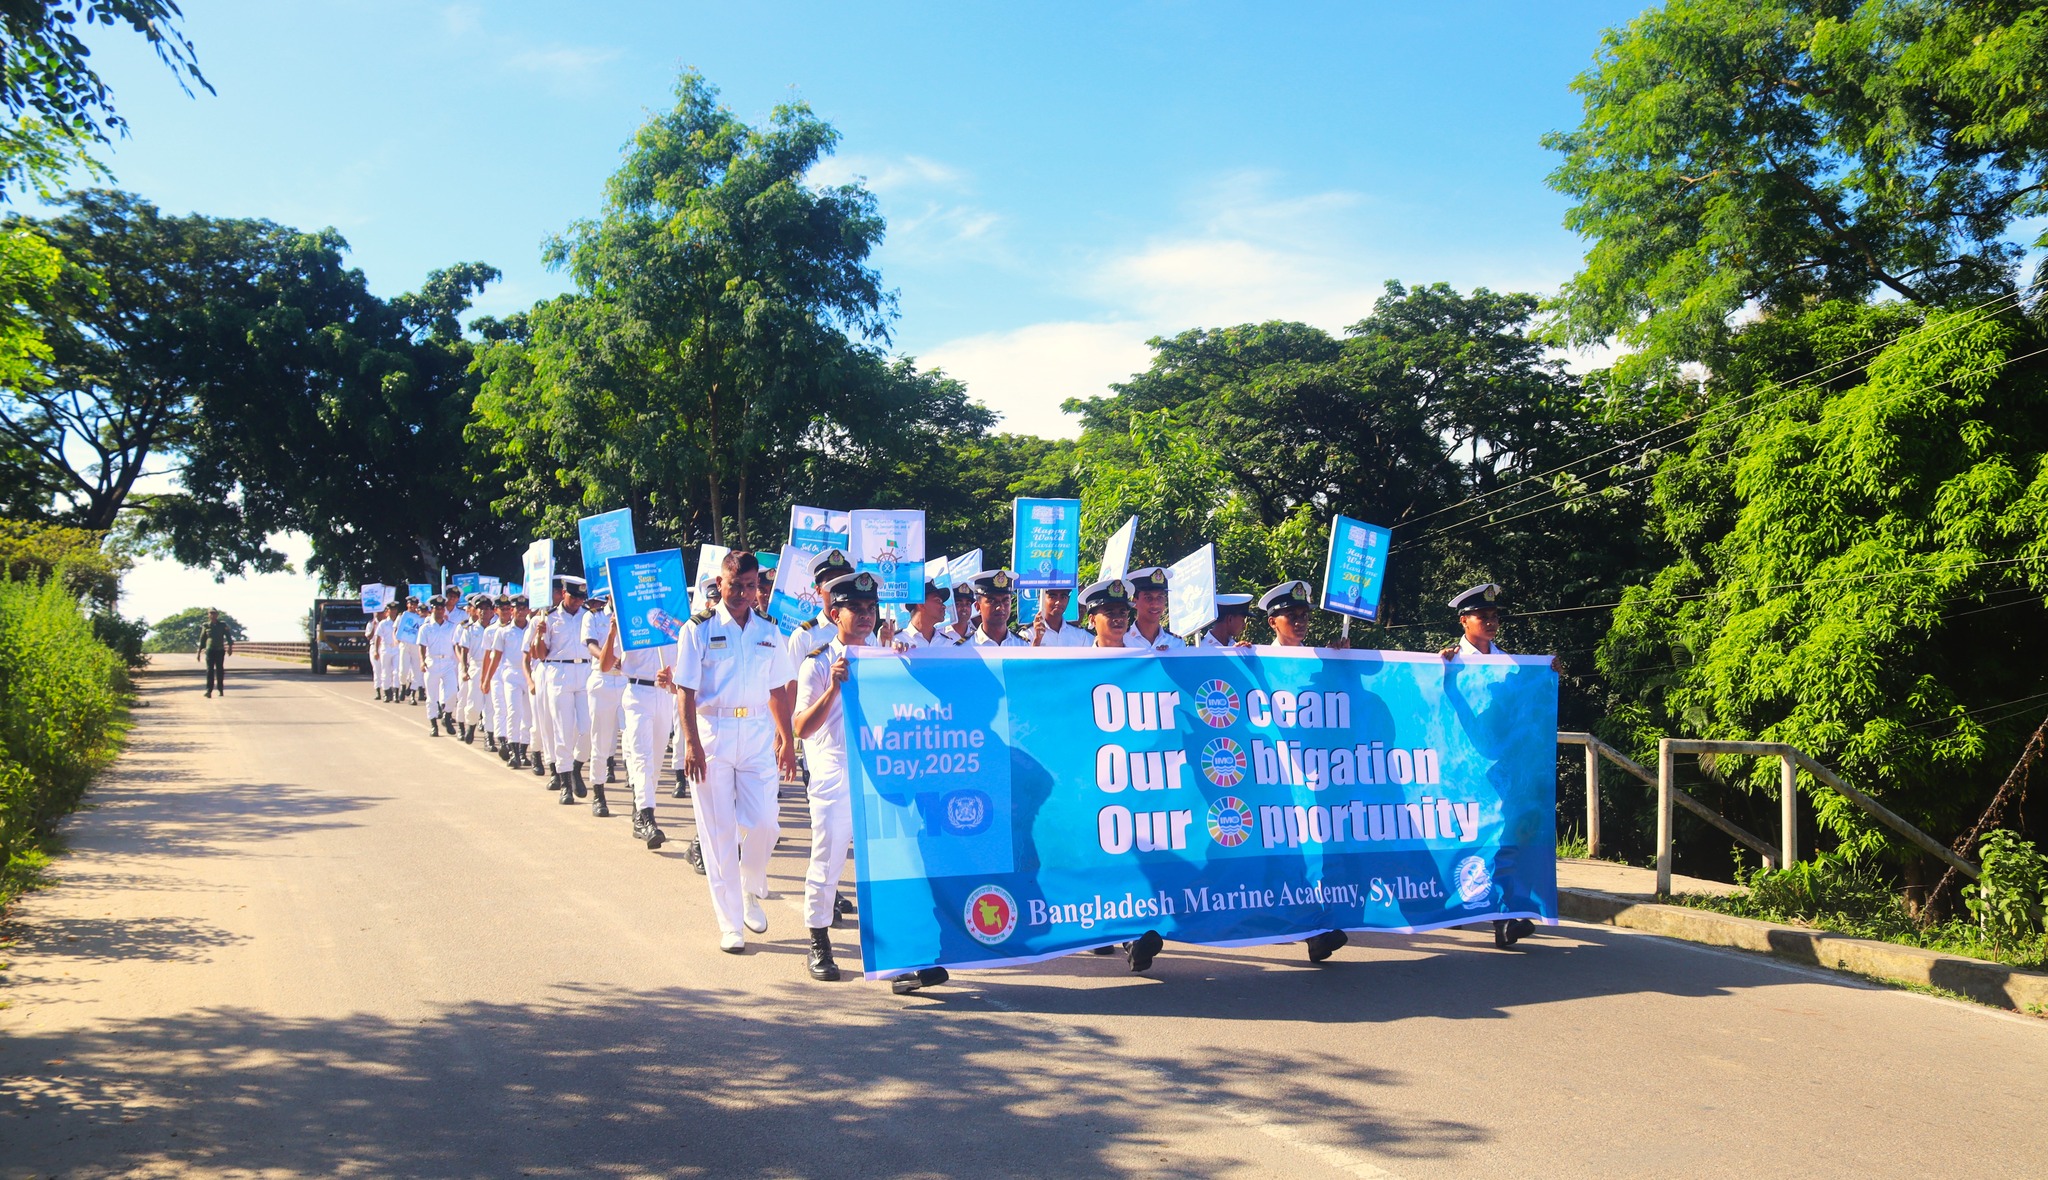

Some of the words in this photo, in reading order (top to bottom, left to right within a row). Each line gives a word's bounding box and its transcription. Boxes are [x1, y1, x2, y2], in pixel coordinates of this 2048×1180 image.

[1031, 526, 1067, 536] Happy
[1033, 533, 1065, 541] World
[892, 702, 953, 722] World
[1091, 684, 1181, 732] Our
[1245, 688, 1351, 729] cean
[1208, 698, 1228, 706] IMO
[860, 725, 985, 751] Maritime
[876, 752, 980, 780] Day,2025
[1095, 744, 1187, 793] Our
[1251, 739, 1440, 792] bligation
[1214, 756, 1234, 766] IMO
[1097, 805, 1193, 855] Our
[1260, 795, 1480, 849] pportunity
[1219, 815, 1240, 825] IMO
[1028, 891, 1176, 929] Bangladesh
[1184, 882, 1277, 914] Marine
[1279, 876, 1366, 908] Academy,
[1370, 876, 1445, 904] Sylhet.
